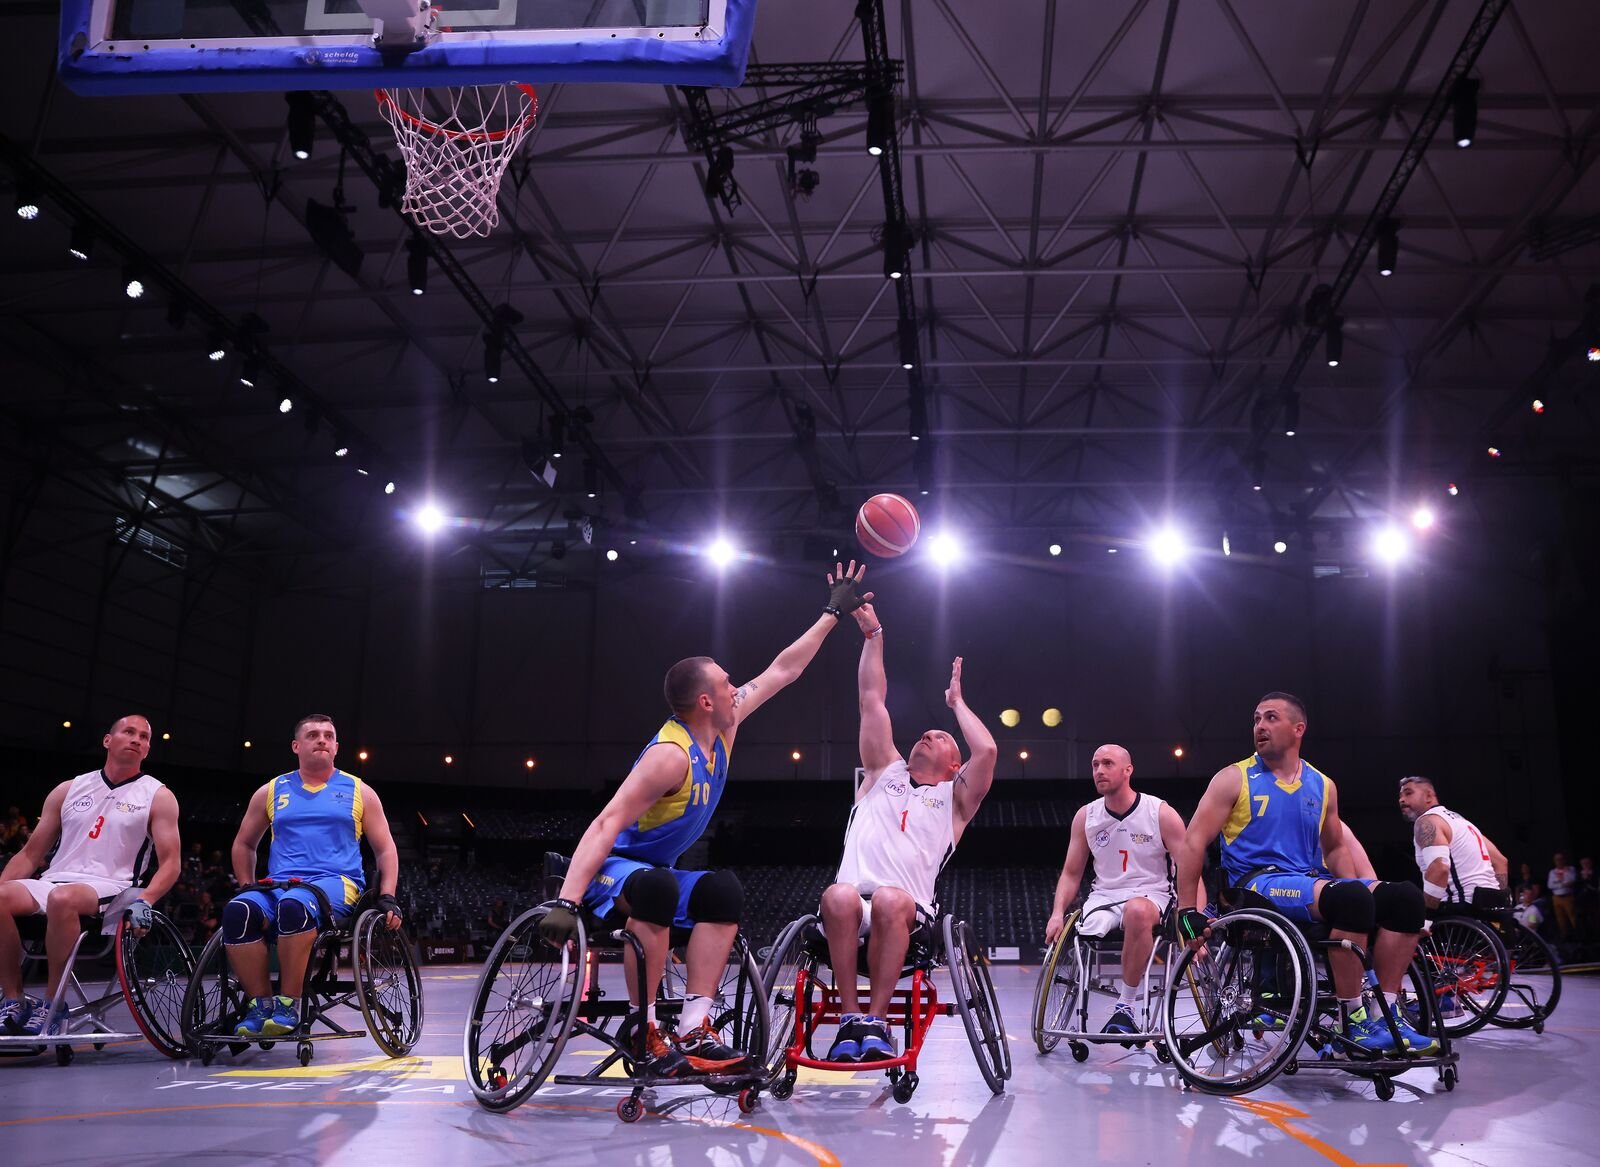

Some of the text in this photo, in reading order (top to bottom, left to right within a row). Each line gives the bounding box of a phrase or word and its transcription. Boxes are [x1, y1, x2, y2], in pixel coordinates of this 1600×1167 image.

[277, 793, 290, 810] 5
[692, 782, 710, 806] 10
[1253, 795, 1270, 817] 7
[88, 815, 105, 839] 3
[901, 809, 909, 833] 1
[1119, 849, 1129, 873] 7
[1269, 887, 1301, 898] UKRAINE
[154, 1080, 334, 1091] THE
